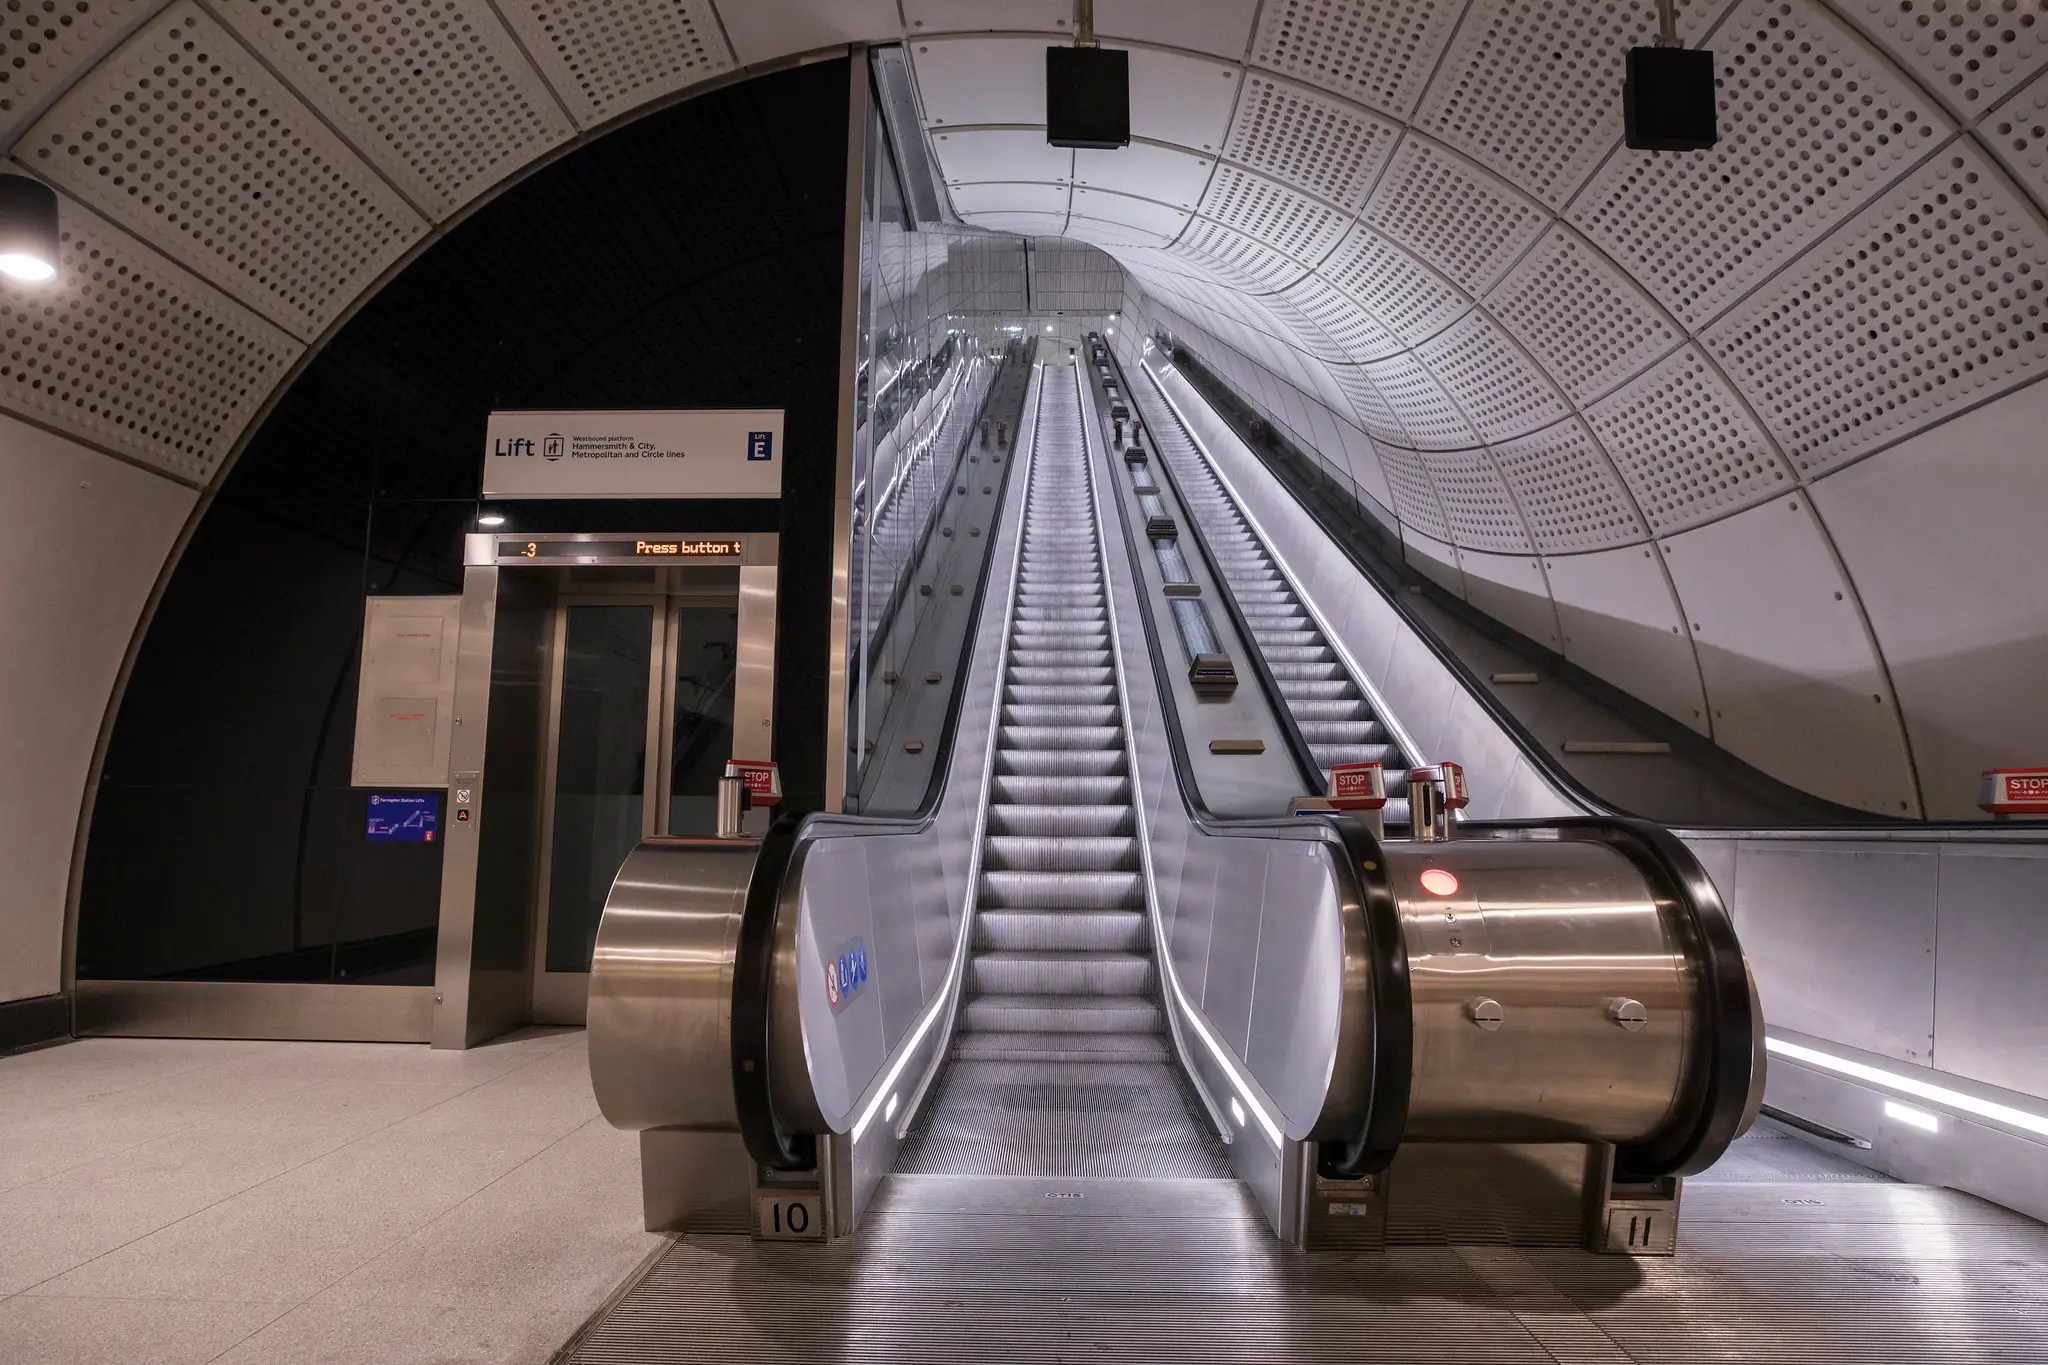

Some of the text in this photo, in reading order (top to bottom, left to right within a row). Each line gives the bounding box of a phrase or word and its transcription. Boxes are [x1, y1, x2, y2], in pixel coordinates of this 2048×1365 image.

[608, 435, 635, 443] platform
[495, 438, 535, 457] Lift
[572, 442, 627, 450] Hammersmith
[629, 442, 635, 450] &
[754, 441, 765, 458] E
[571, 451, 623, 459] Metropolitan
[641, 450, 664, 458] Circle
[666, 450, 685, 458] lines
[520, 542, 537, 558] -3
[636, 541, 678, 554] Press
[681, 541, 729, 554] button
[744, 771, 769, 782] STOP
[1339, 774, 1365, 786] STOP
[2010, 778, 2048, 789] STOP
[773, 1202, 809, 1234] 10
[1628, 1215, 1652, 1247] 11
